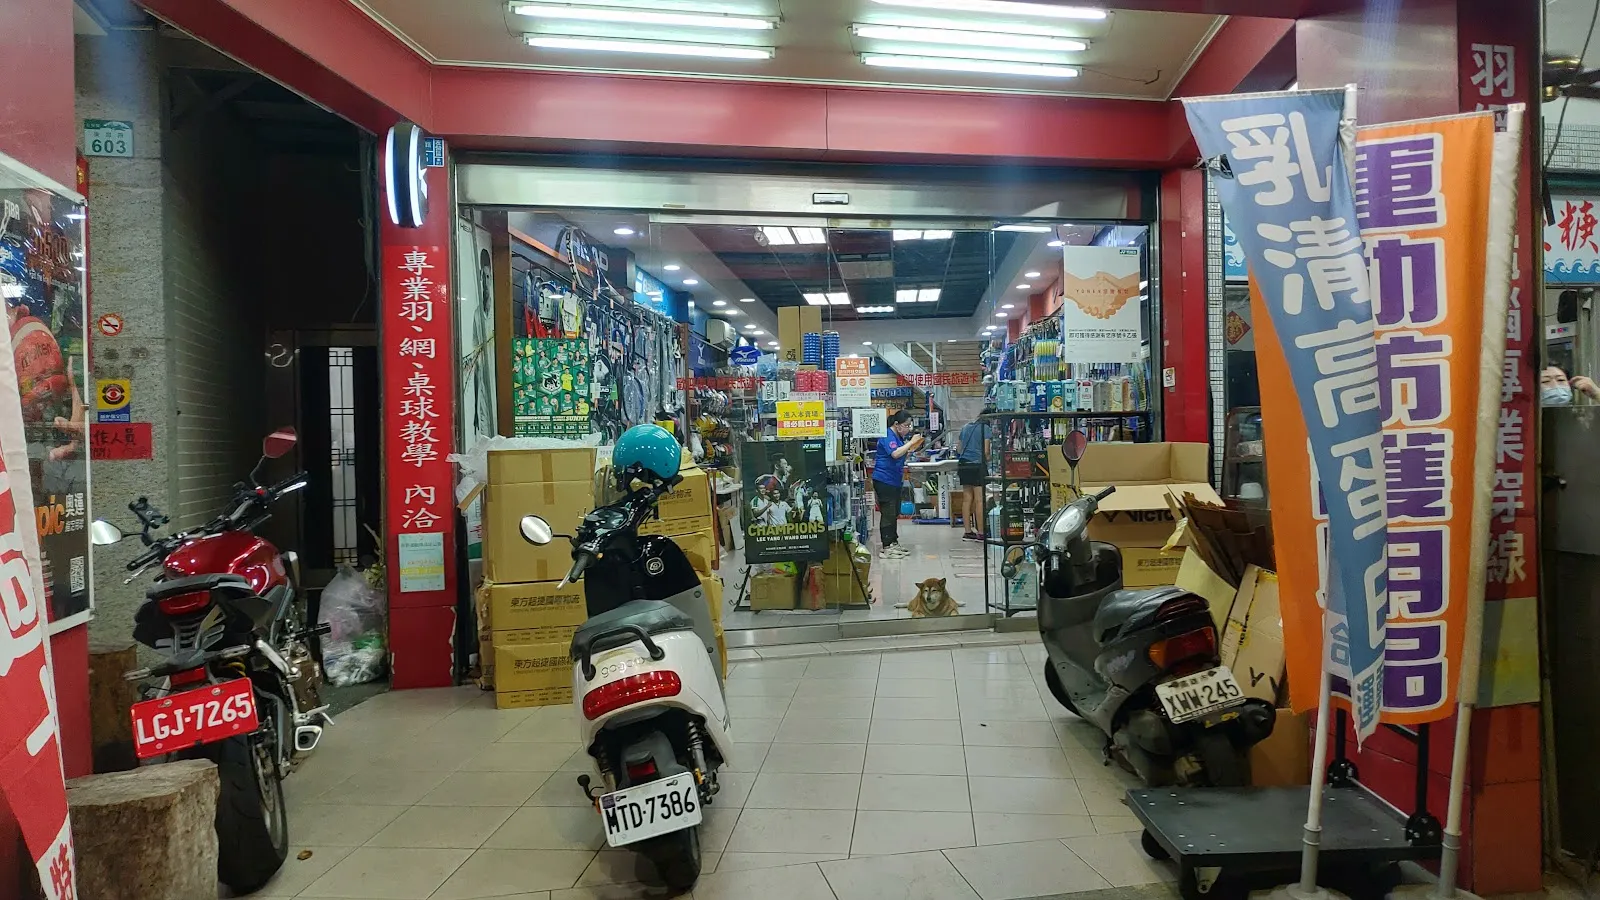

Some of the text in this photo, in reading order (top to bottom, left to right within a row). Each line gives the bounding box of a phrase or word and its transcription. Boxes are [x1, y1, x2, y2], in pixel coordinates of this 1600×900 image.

[92, 139, 127, 154] 603
[398, 250, 440, 468] 專業羽、網、桌球教學
[90, 427, 137, 446] 作人員
[402, 483, 442, 530] 內洽
[747, 522, 825, 536] CHAMPIONS
[136, 692, 251, 745] LGJ-7265
[605, 787, 696, 835] MTD-7386
